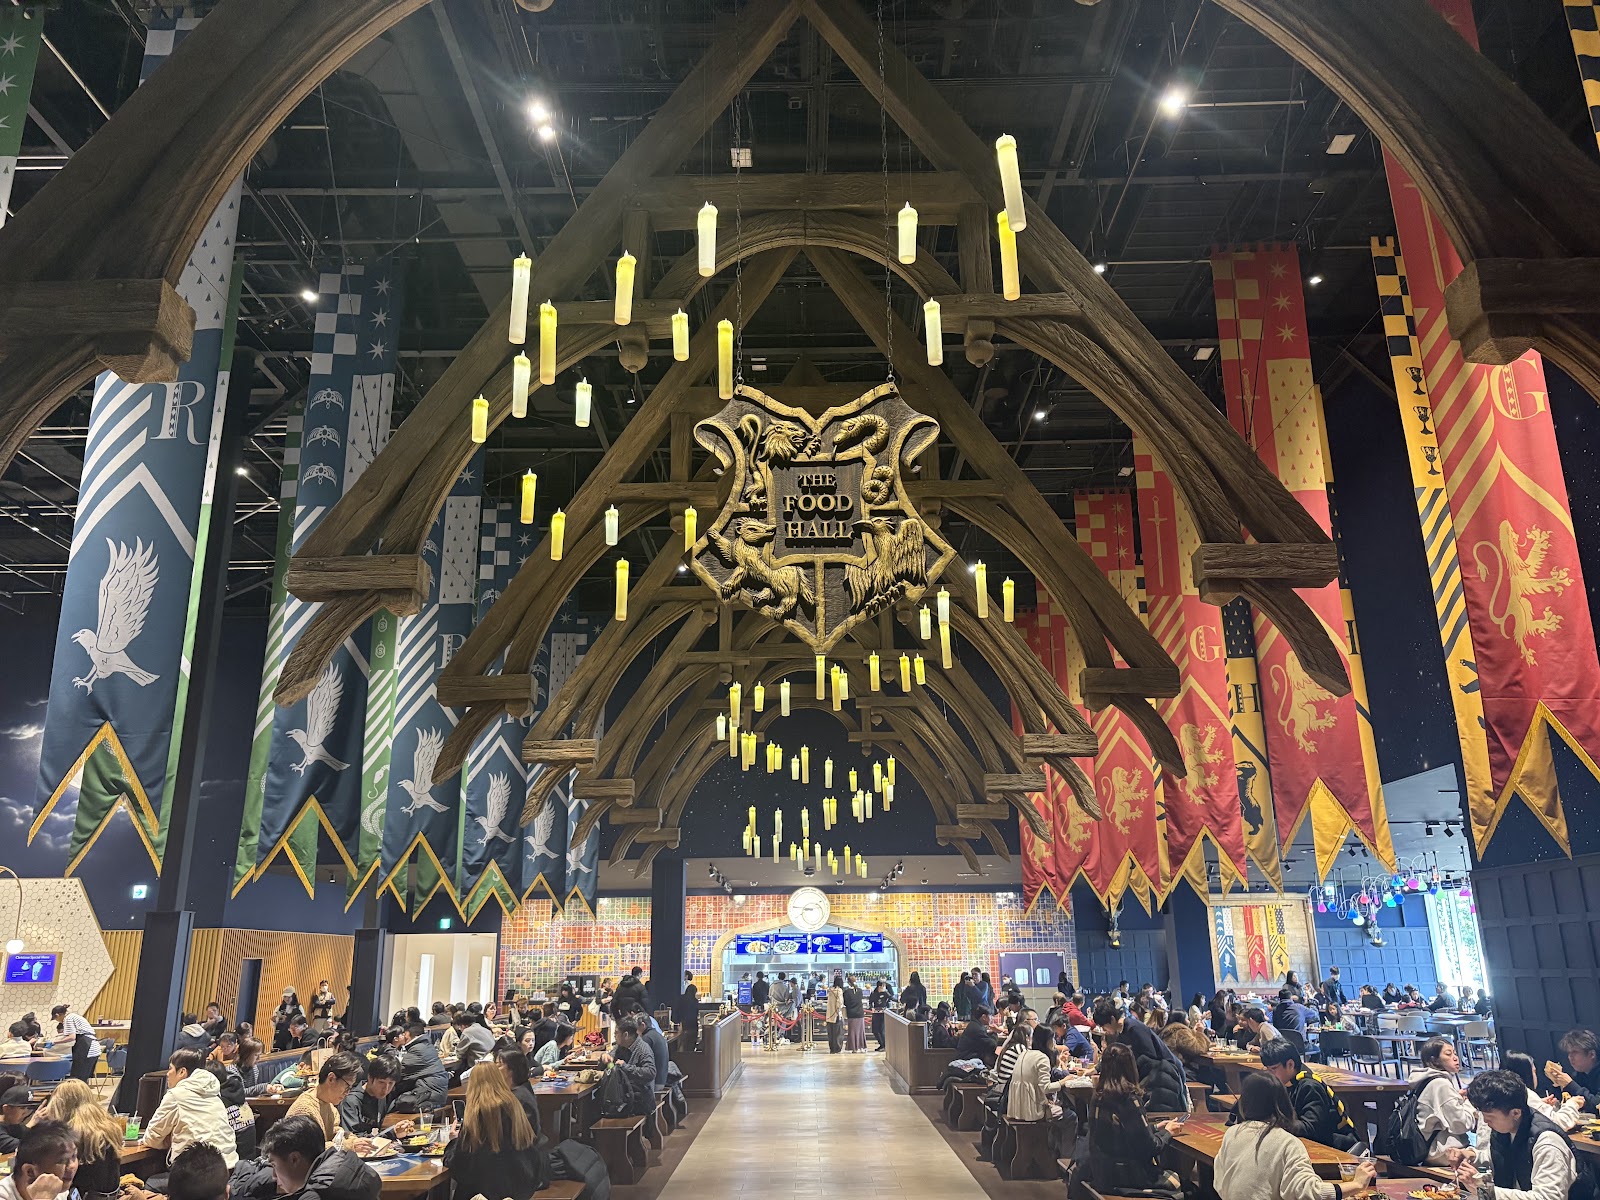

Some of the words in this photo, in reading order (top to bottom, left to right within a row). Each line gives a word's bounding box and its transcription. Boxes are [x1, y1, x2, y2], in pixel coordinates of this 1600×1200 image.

[1490, 359, 1547, 420] G
[150, 381, 207, 445] R
[799, 473, 836, 487] THE
[783, 494, 853, 512] FOOD
[785, 520, 854, 539] HALL
[1190, 625, 1222, 662] G
[1233, 684, 1261, 713] H
